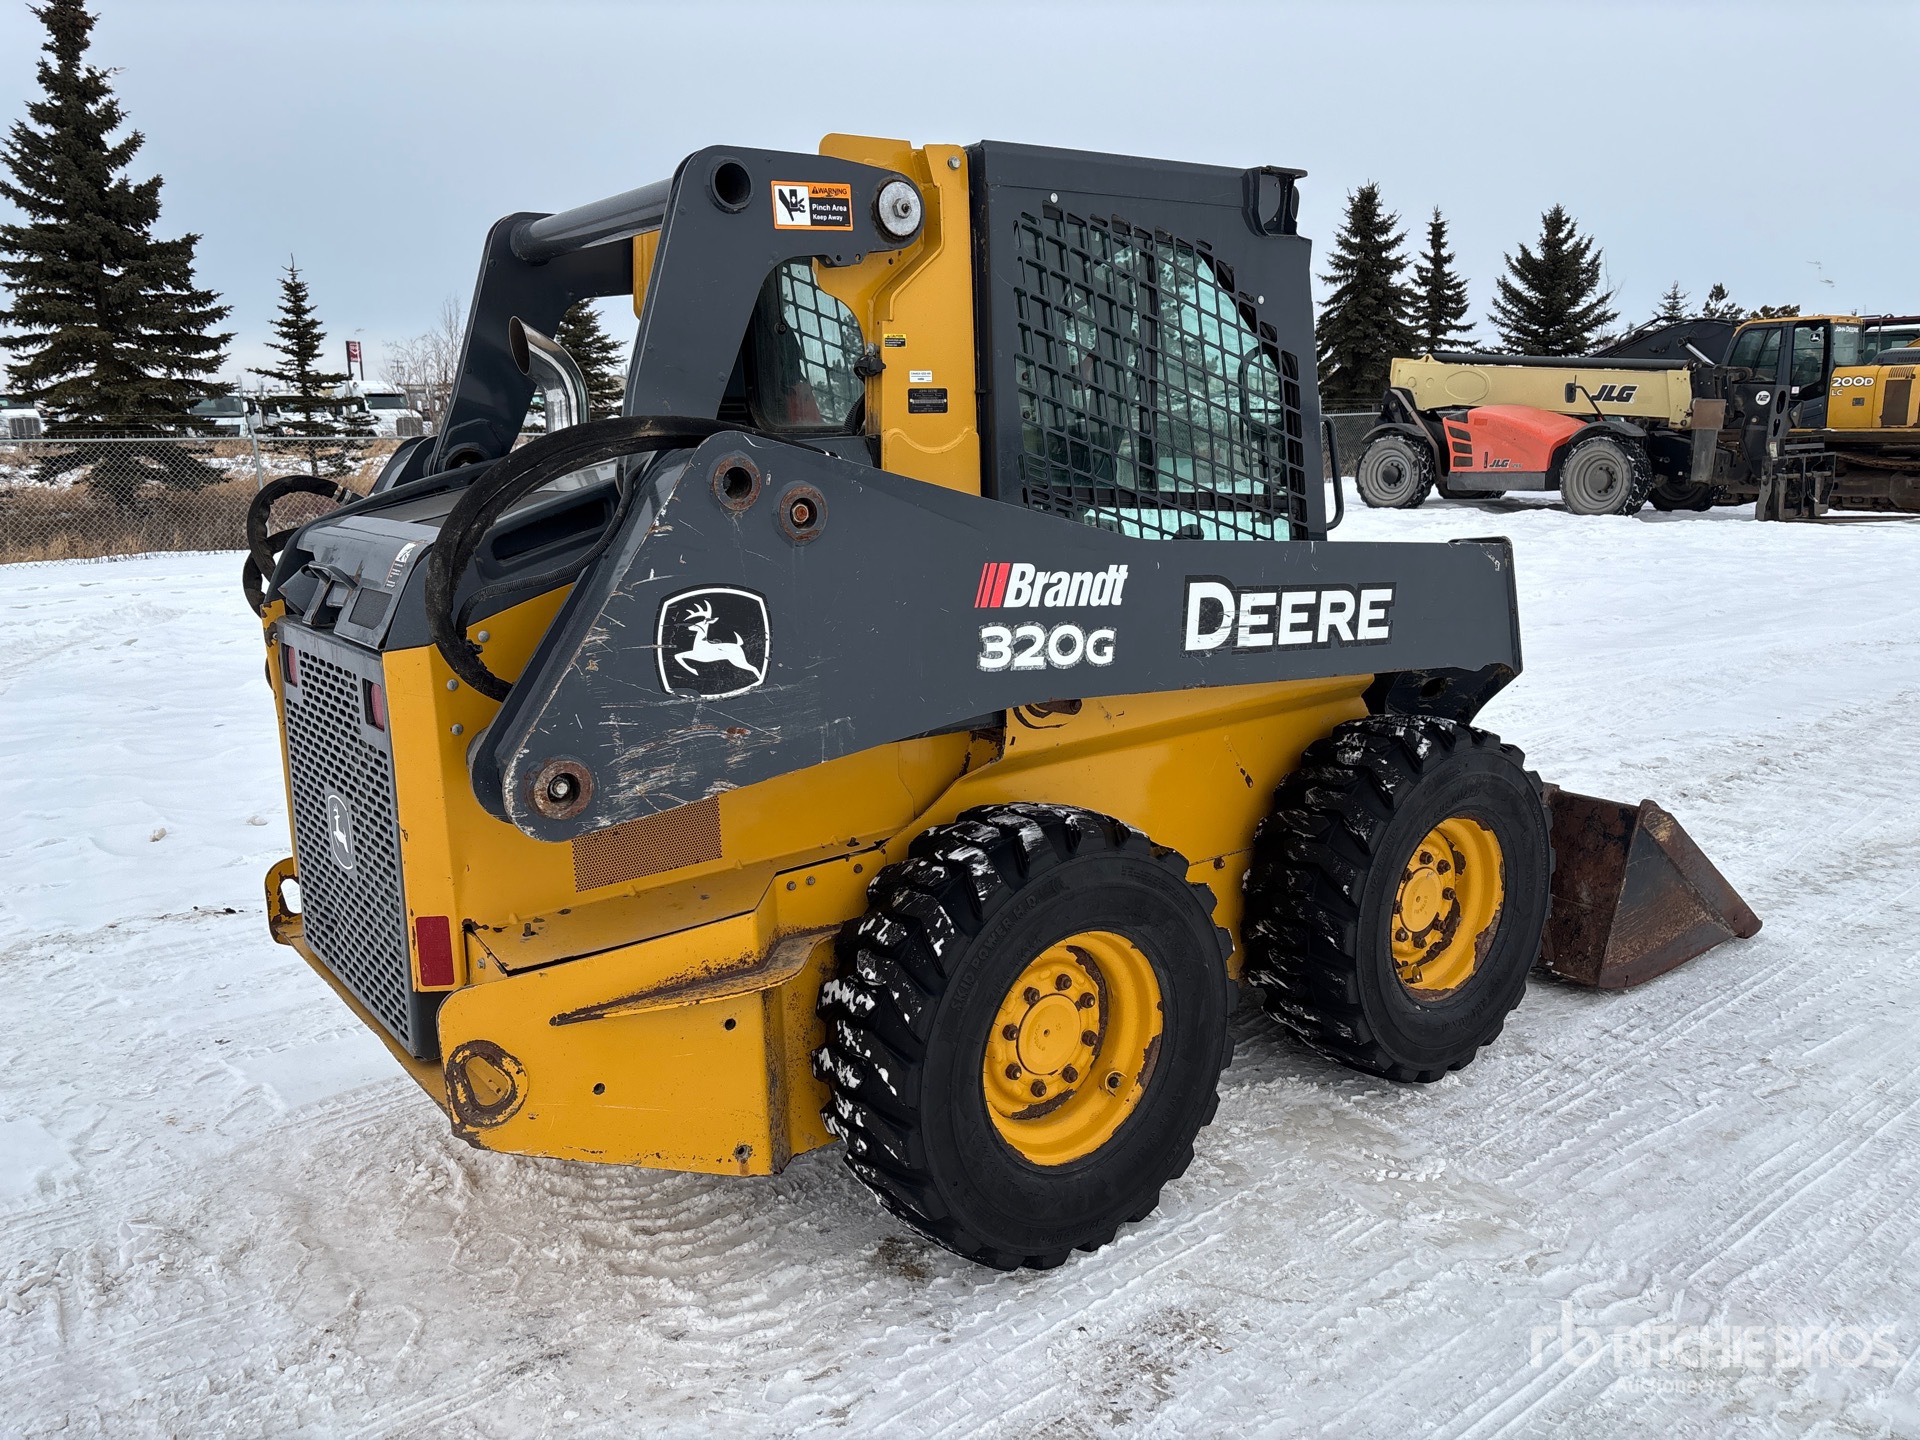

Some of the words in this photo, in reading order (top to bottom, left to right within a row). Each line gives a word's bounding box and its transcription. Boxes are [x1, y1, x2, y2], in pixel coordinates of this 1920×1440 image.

[818, 187, 847, 195] WARNING
[812, 203, 831, 211] Pinch
[832, 204, 847, 212] Area
[812, 213, 828, 221] Keep
[1831, 376, 1875, 387] 200D
[1590, 384, 1638, 403] JLG
[1757, 394, 1770, 402] 12
[1489, 459, 1510, 468] JLG
[1003, 562, 1128, 608] Brandt
[1184, 581, 1393, 651] DEERE
[978, 623, 1116, 669] 320G
[951, 972, 975, 1011] SKID
[972, 917, 1014, 971] POWER
